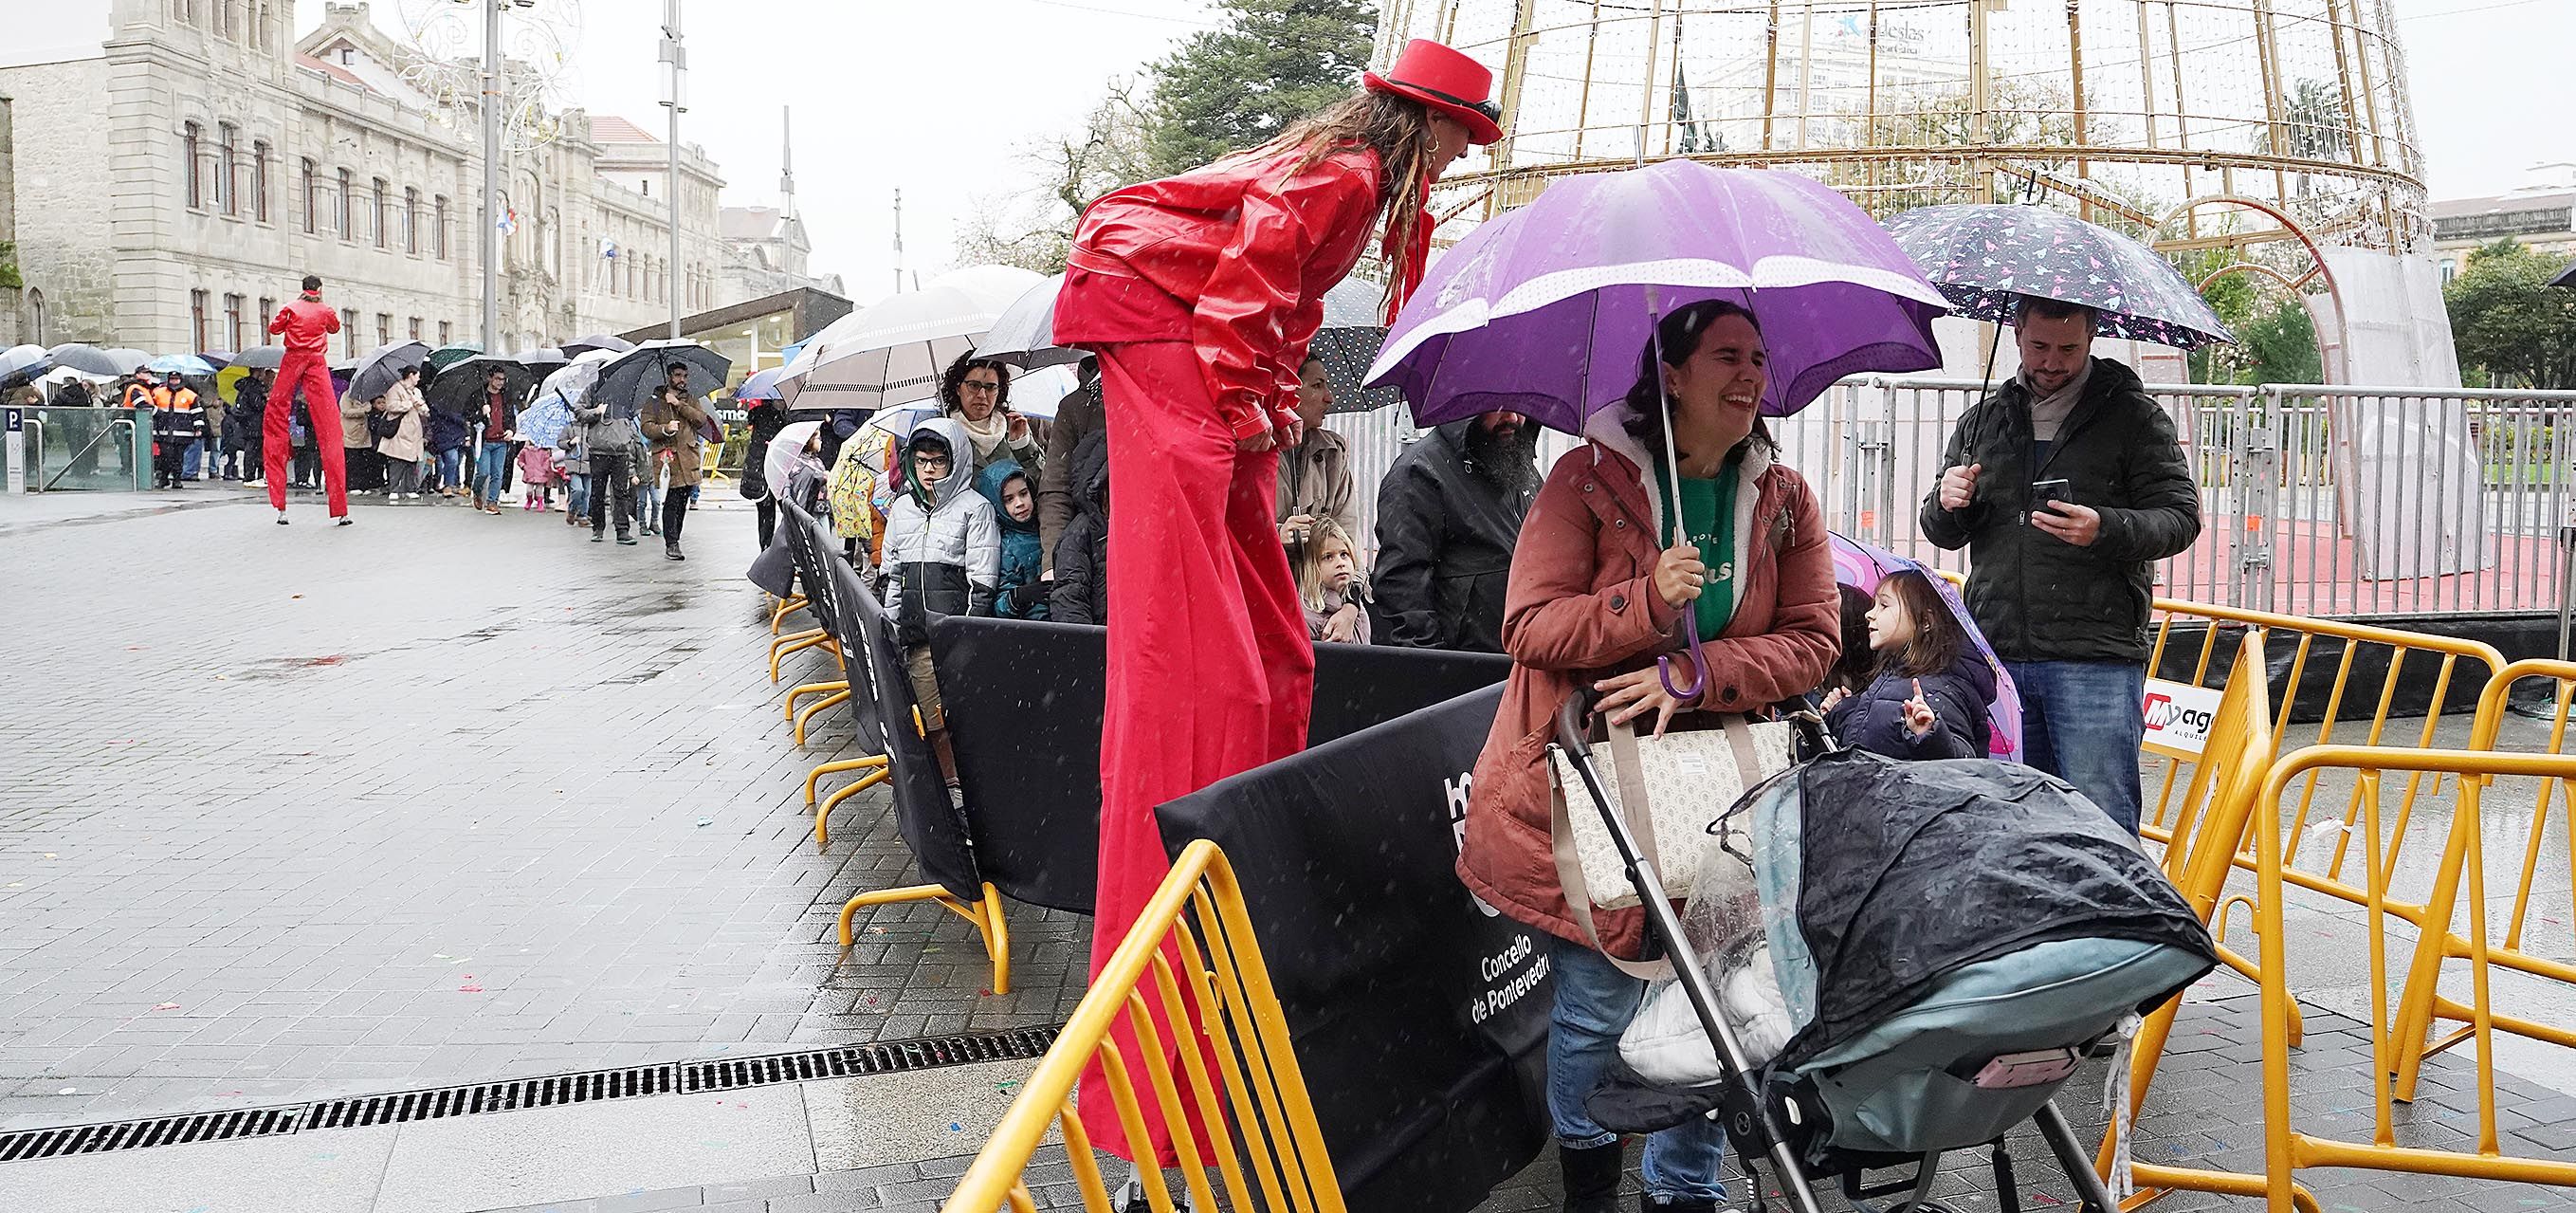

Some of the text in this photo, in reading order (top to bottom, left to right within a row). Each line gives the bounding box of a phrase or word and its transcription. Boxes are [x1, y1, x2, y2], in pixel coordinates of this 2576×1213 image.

[9, 411, 18, 429] P
[1481, 933, 1532, 983] Concello
[1471, 952, 1551, 1025] de Pontevedr
